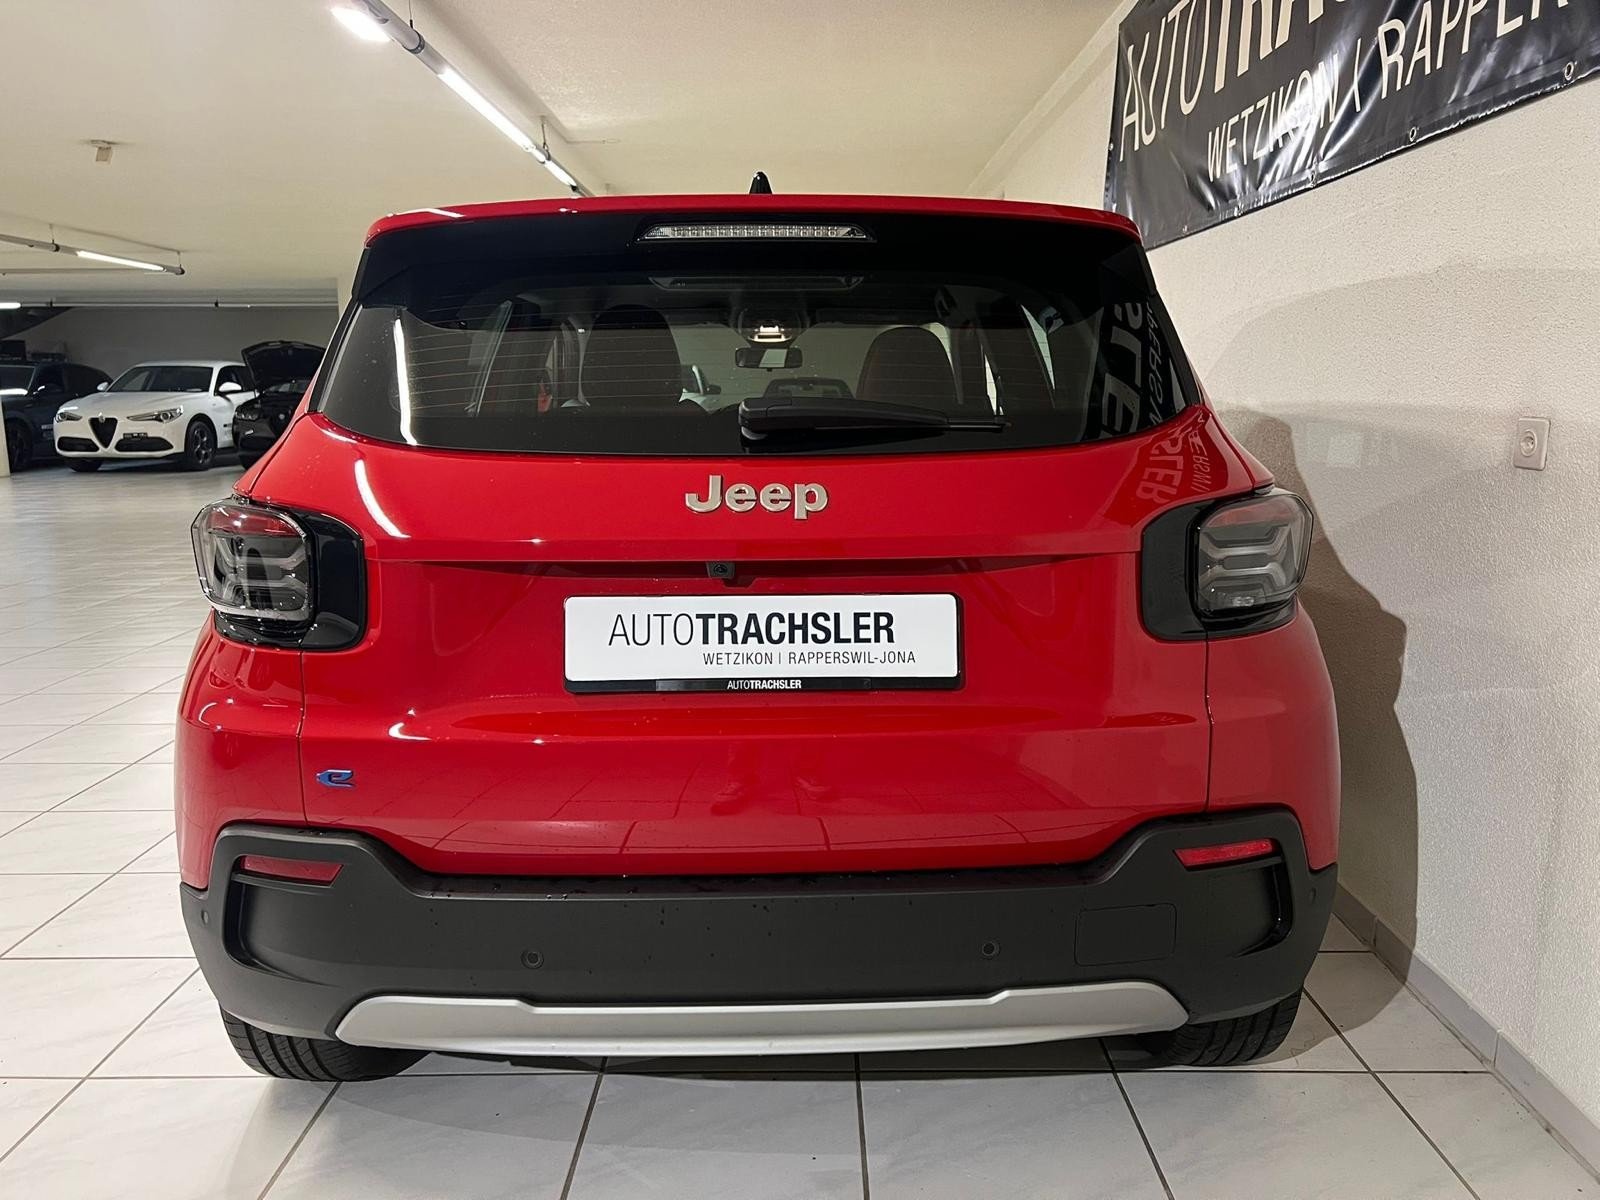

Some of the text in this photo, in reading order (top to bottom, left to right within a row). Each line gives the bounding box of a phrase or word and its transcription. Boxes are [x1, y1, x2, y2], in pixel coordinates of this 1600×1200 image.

[1207, 53, 1339, 182] WETZIKON
[685, 474, 829, 520] Jeep
[608, 612, 895, 646] AUTOTRACHSLER
[703, 652, 773, 665] WETZIKON
[788, 651, 916, 665] RAPPERSWIL-JONA
[727, 679, 802, 690] AUTOTRACHSLER
